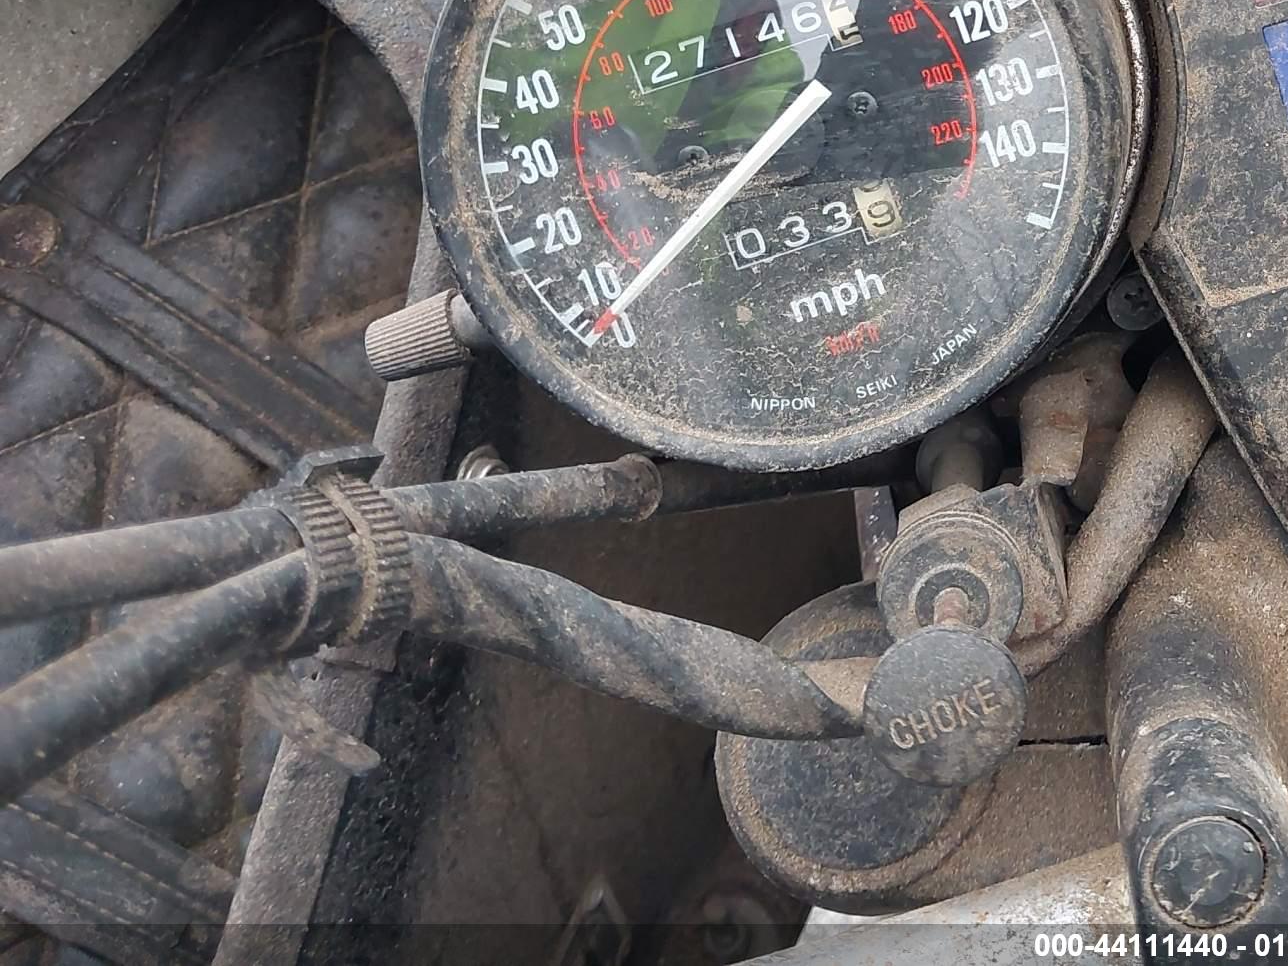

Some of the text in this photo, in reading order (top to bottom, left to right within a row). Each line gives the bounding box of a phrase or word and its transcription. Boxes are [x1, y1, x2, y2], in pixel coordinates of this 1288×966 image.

[538, 4, 586, 52] 50
[888, 10, 917, 35] 180
[599, 52, 625, 76] 80
[921, 62, 954, 90] 200
[976, 57, 1034, 106] 130
[516, 70, 560, 114] 40
[590, 106, 616, 130] 60
[930, 120, 963, 146] 220
[511, 138, 559, 184] 30
[979, 120, 1037, 168] 140
[536, 207, 582, 254] 20
[628, 226, 655, 250] 20
[578, 262, 621, 306] 10
[790, 269, 887, 323] mph
[611, 311, 636, 348] 0
[750, 323, 978, 413] NIPPON SEIKI JAPAN
[888, 678, 1001, 750] CHOKE
